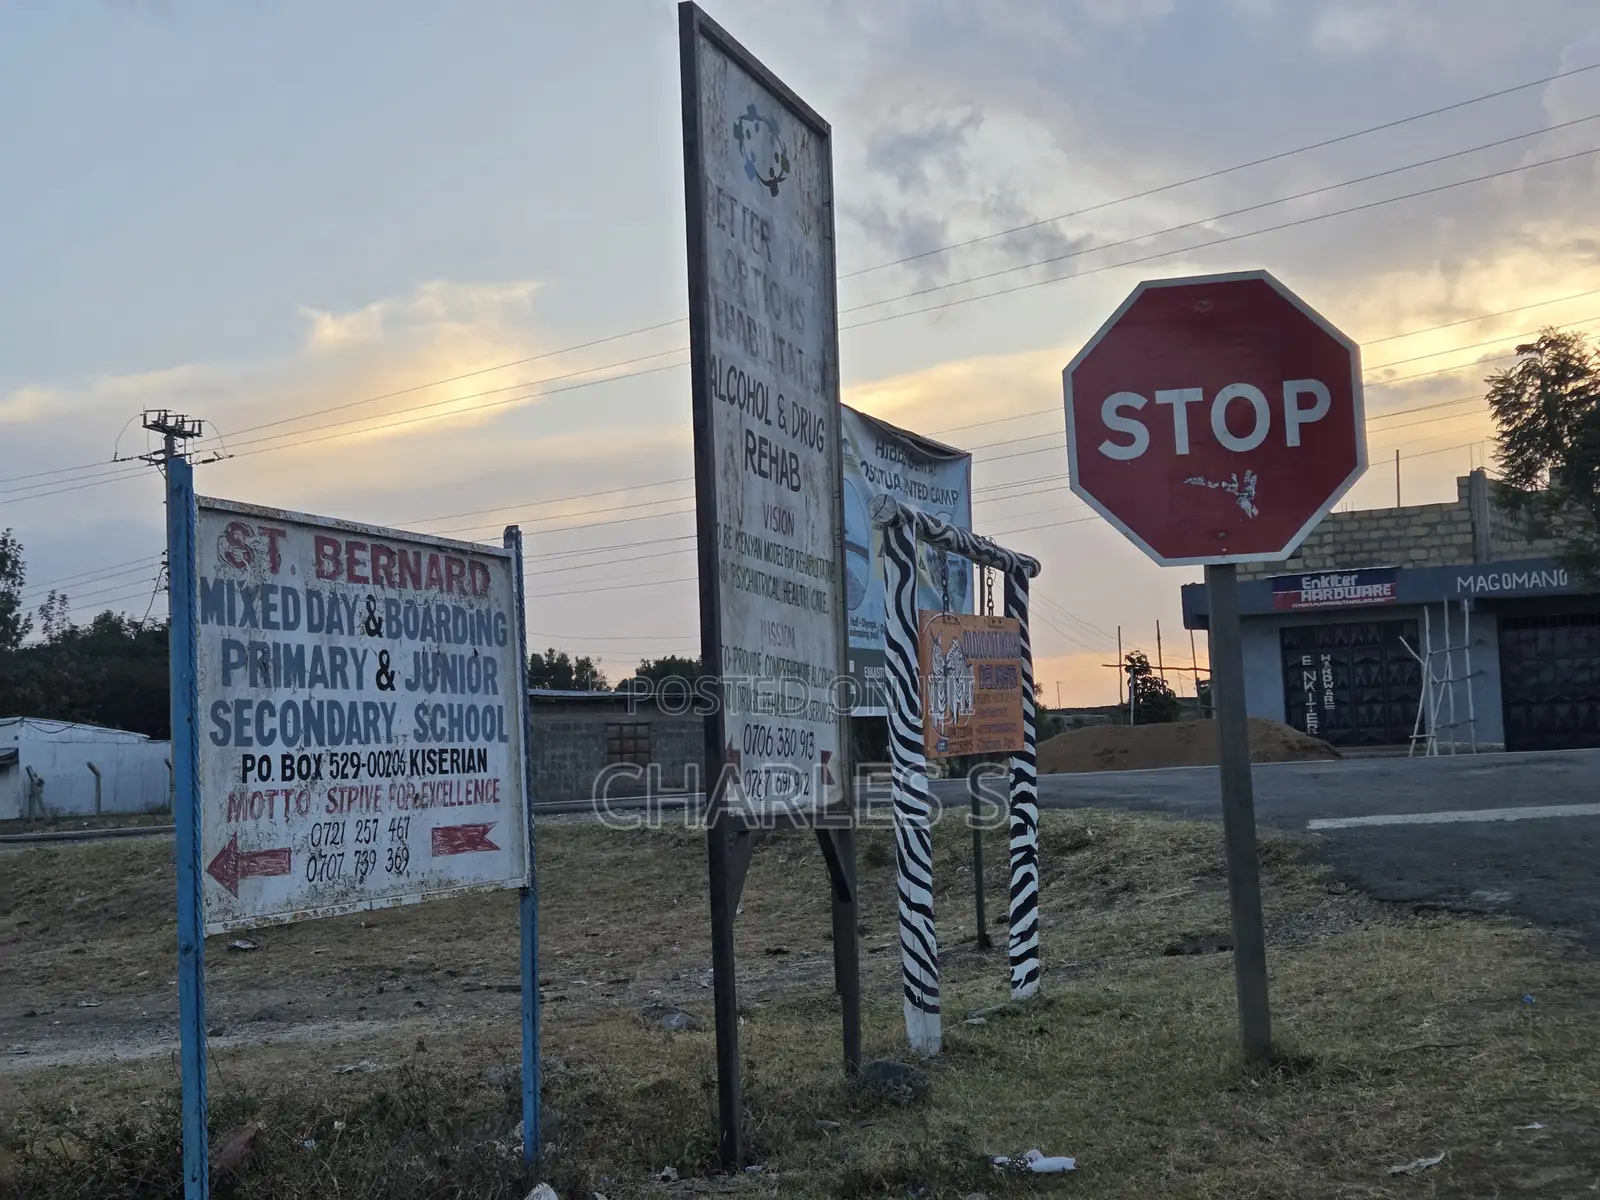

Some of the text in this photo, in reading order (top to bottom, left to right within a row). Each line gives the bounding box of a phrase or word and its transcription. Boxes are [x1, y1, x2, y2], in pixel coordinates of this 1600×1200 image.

[711, 354, 825, 453] ALCOHOL & DRUG
[1098, 378, 1331, 460] STOP
[745, 428, 801, 493] REHAB
[930, 485, 959, 506] CAMP
[763, 502, 795, 537] VISION
[217, 520, 491, 598] ST. BERNARD
[723, 524, 732, 549] BE
[735, 528, 762, 560] KENYAN
[764, 540, 783, 566] MODEL
[784, 546, 794, 570] FOR
[783, 580, 808, 609] HEALTH
[1300, 583, 1391, 602] HARDWARE
[1457, 569, 1568, 593] MAGOMANO
[200, 576, 508, 648] MIXED DAY & BOARDING
[221, 638, 499, 696] PRIMARY & JUNIOR
[1321, 654, 1335, 710] HARDWARE
[1302, 655, 1318, 735] ENKITER
[210, 699, 509, 748] SECONDARY SCHOOL
[743, 723, 815, 760] 0706 380 913
[281, 752, 323, 781] BOX
[409, 748, 488, 777] KISERIAN
[745, 769, 771, 797] 0787
[227, 788, 311, 823] MOTTO
[419, 778, 501, 809] EXCELLENCE
[311, 817, 411, 847] 0721 257 467
[306, 847, 410, 882] 0707 739 369
